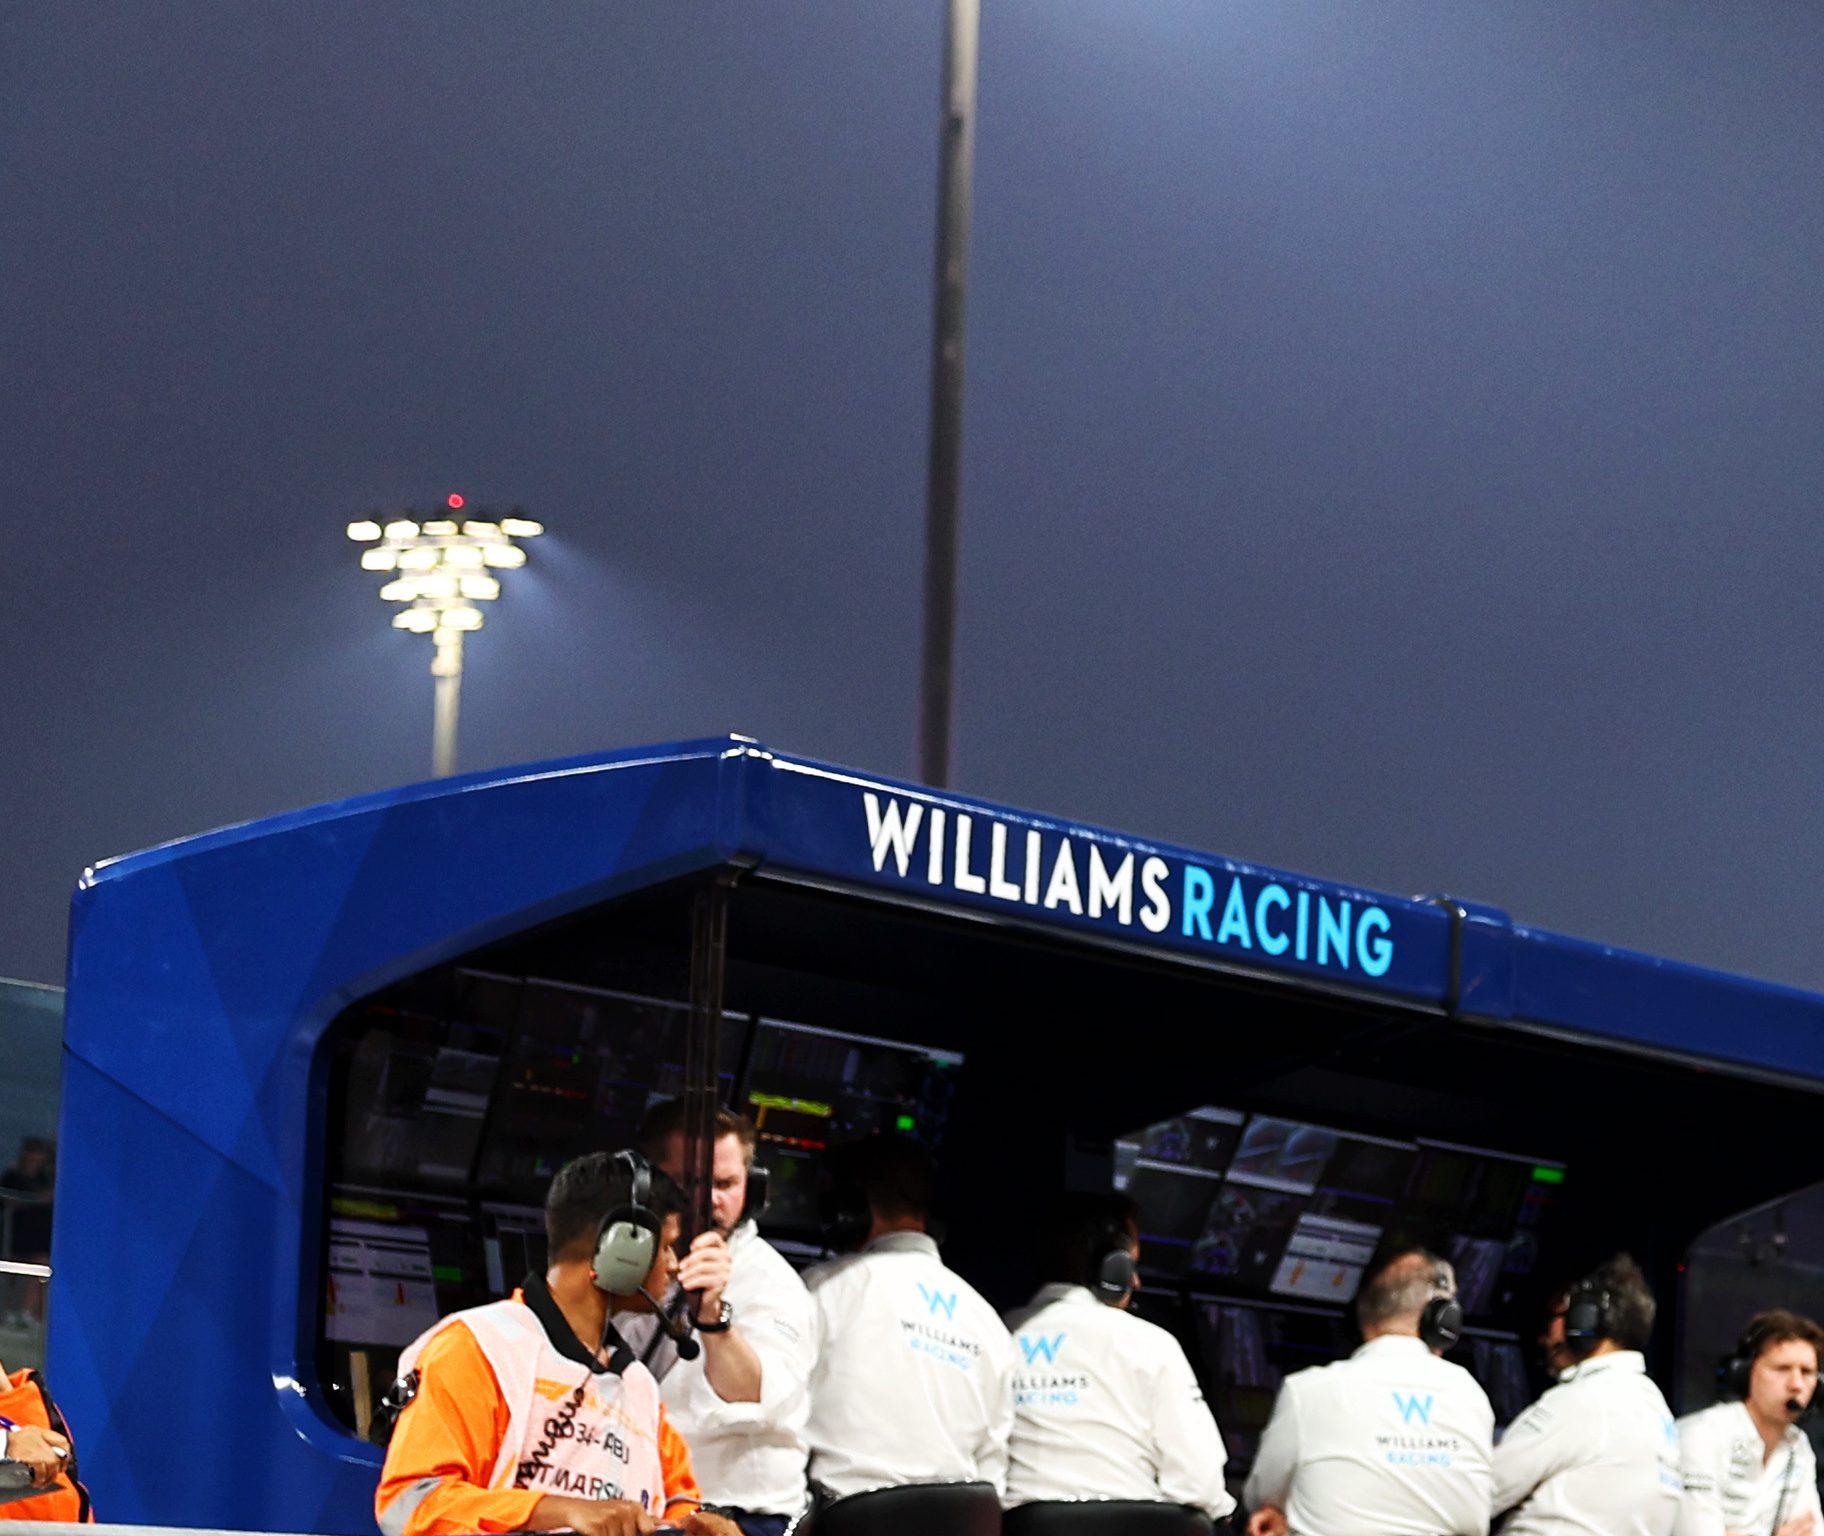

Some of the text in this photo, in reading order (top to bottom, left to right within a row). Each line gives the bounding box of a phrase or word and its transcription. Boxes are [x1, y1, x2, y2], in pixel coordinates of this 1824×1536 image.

[863, 792, 1393, 977] WILLIAMS RACING
[1011, 1375, 1089, 1390] ILLIAMS
